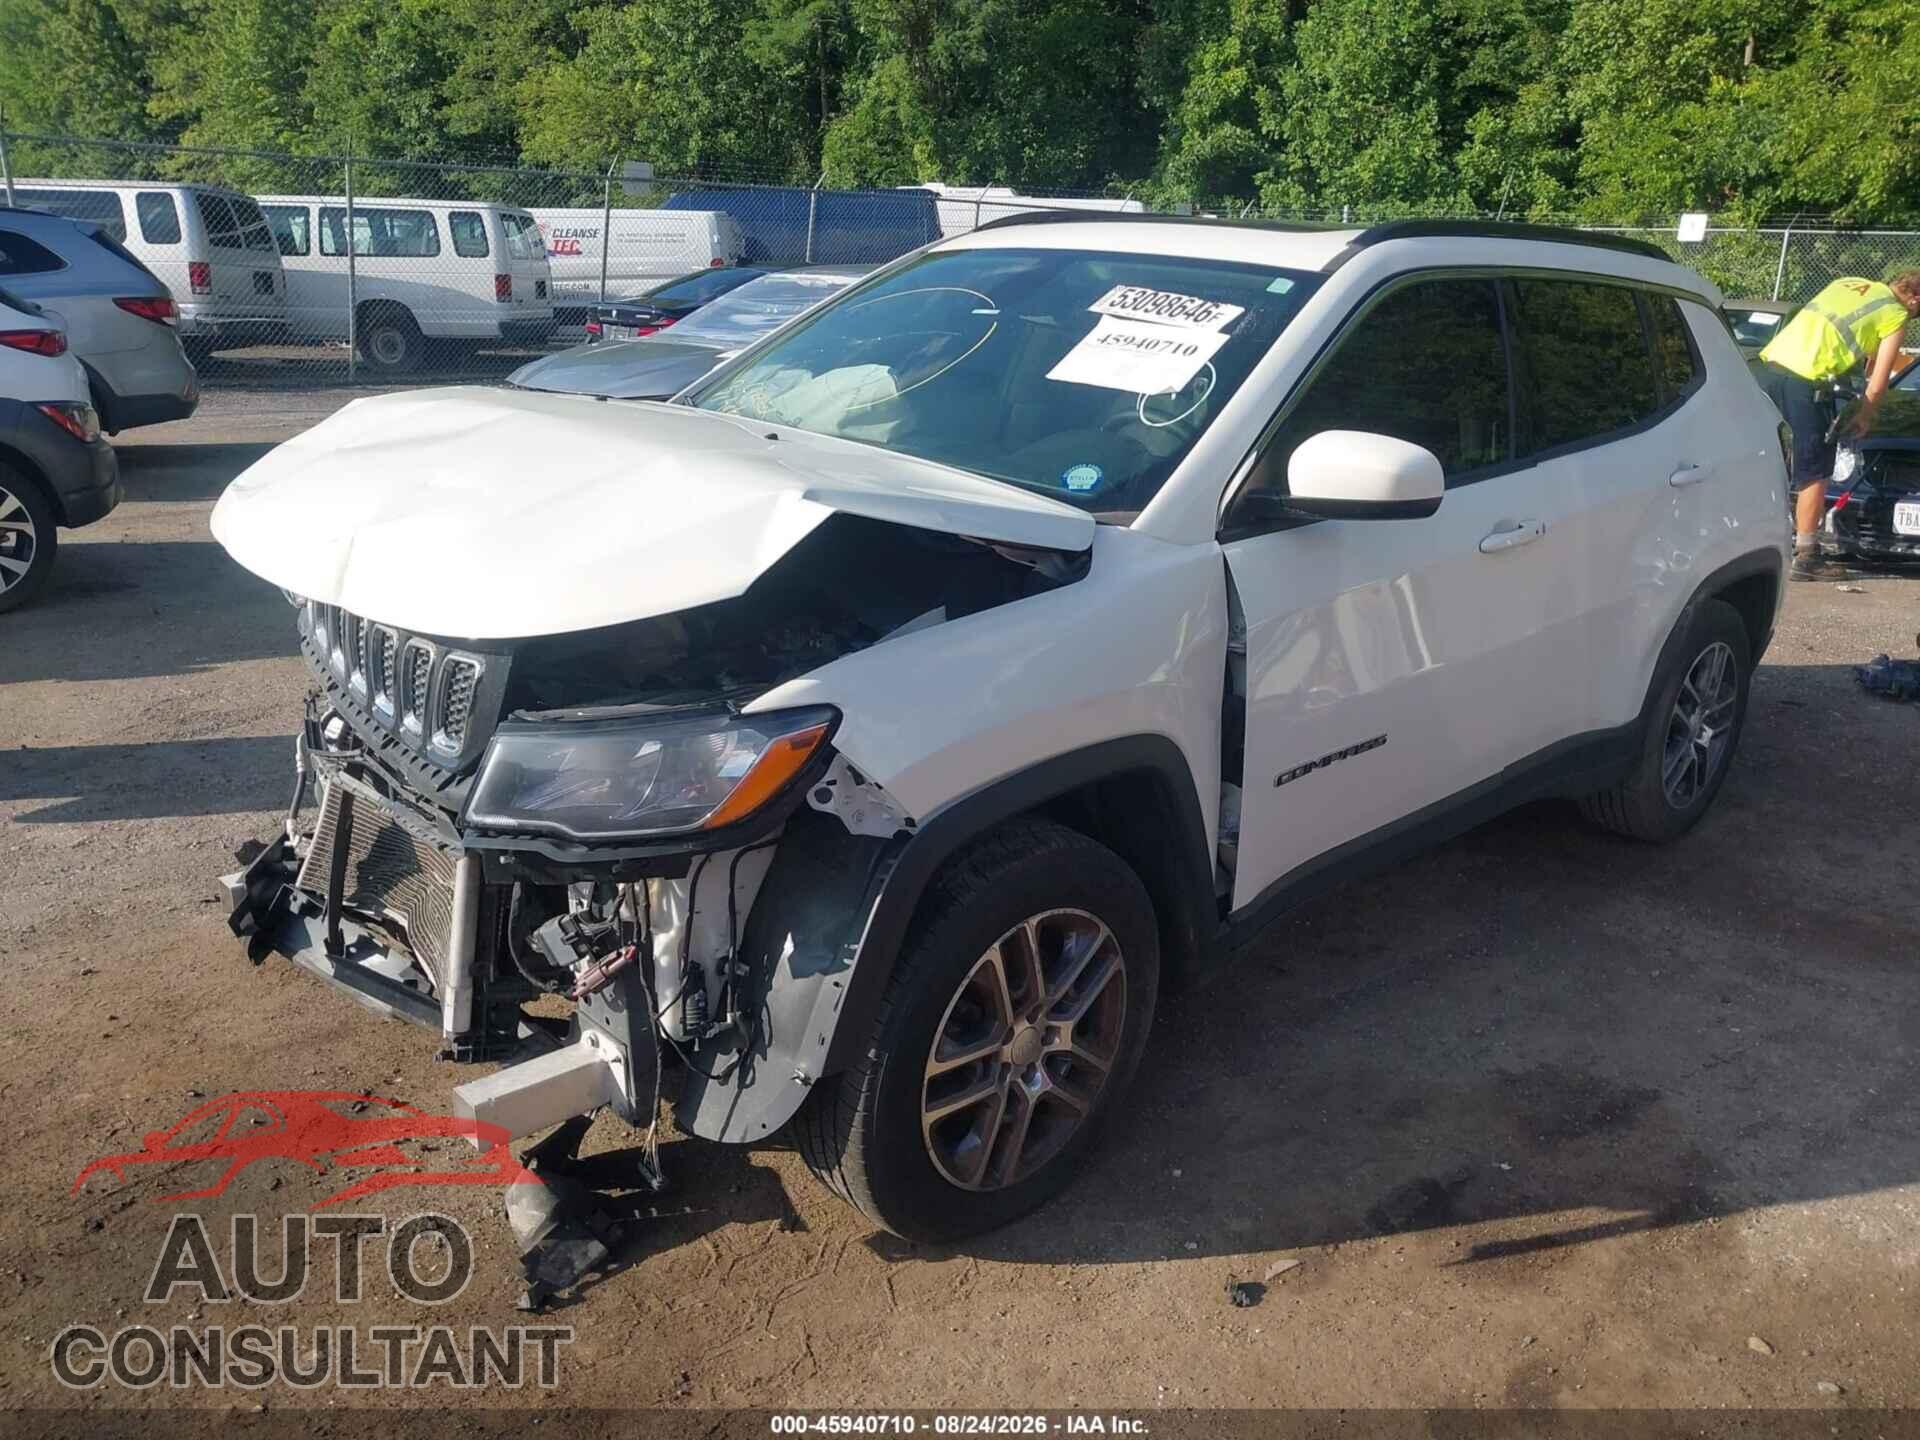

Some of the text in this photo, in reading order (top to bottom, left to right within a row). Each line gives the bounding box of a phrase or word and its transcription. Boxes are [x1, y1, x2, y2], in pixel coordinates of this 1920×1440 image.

[552, 228, 599, 238] CLEANSE
[553, 240, 580, 252] TEC
[1097, 333, 1198, 356] 45940710
[1274, 733, 1388, 787] COMPASS
